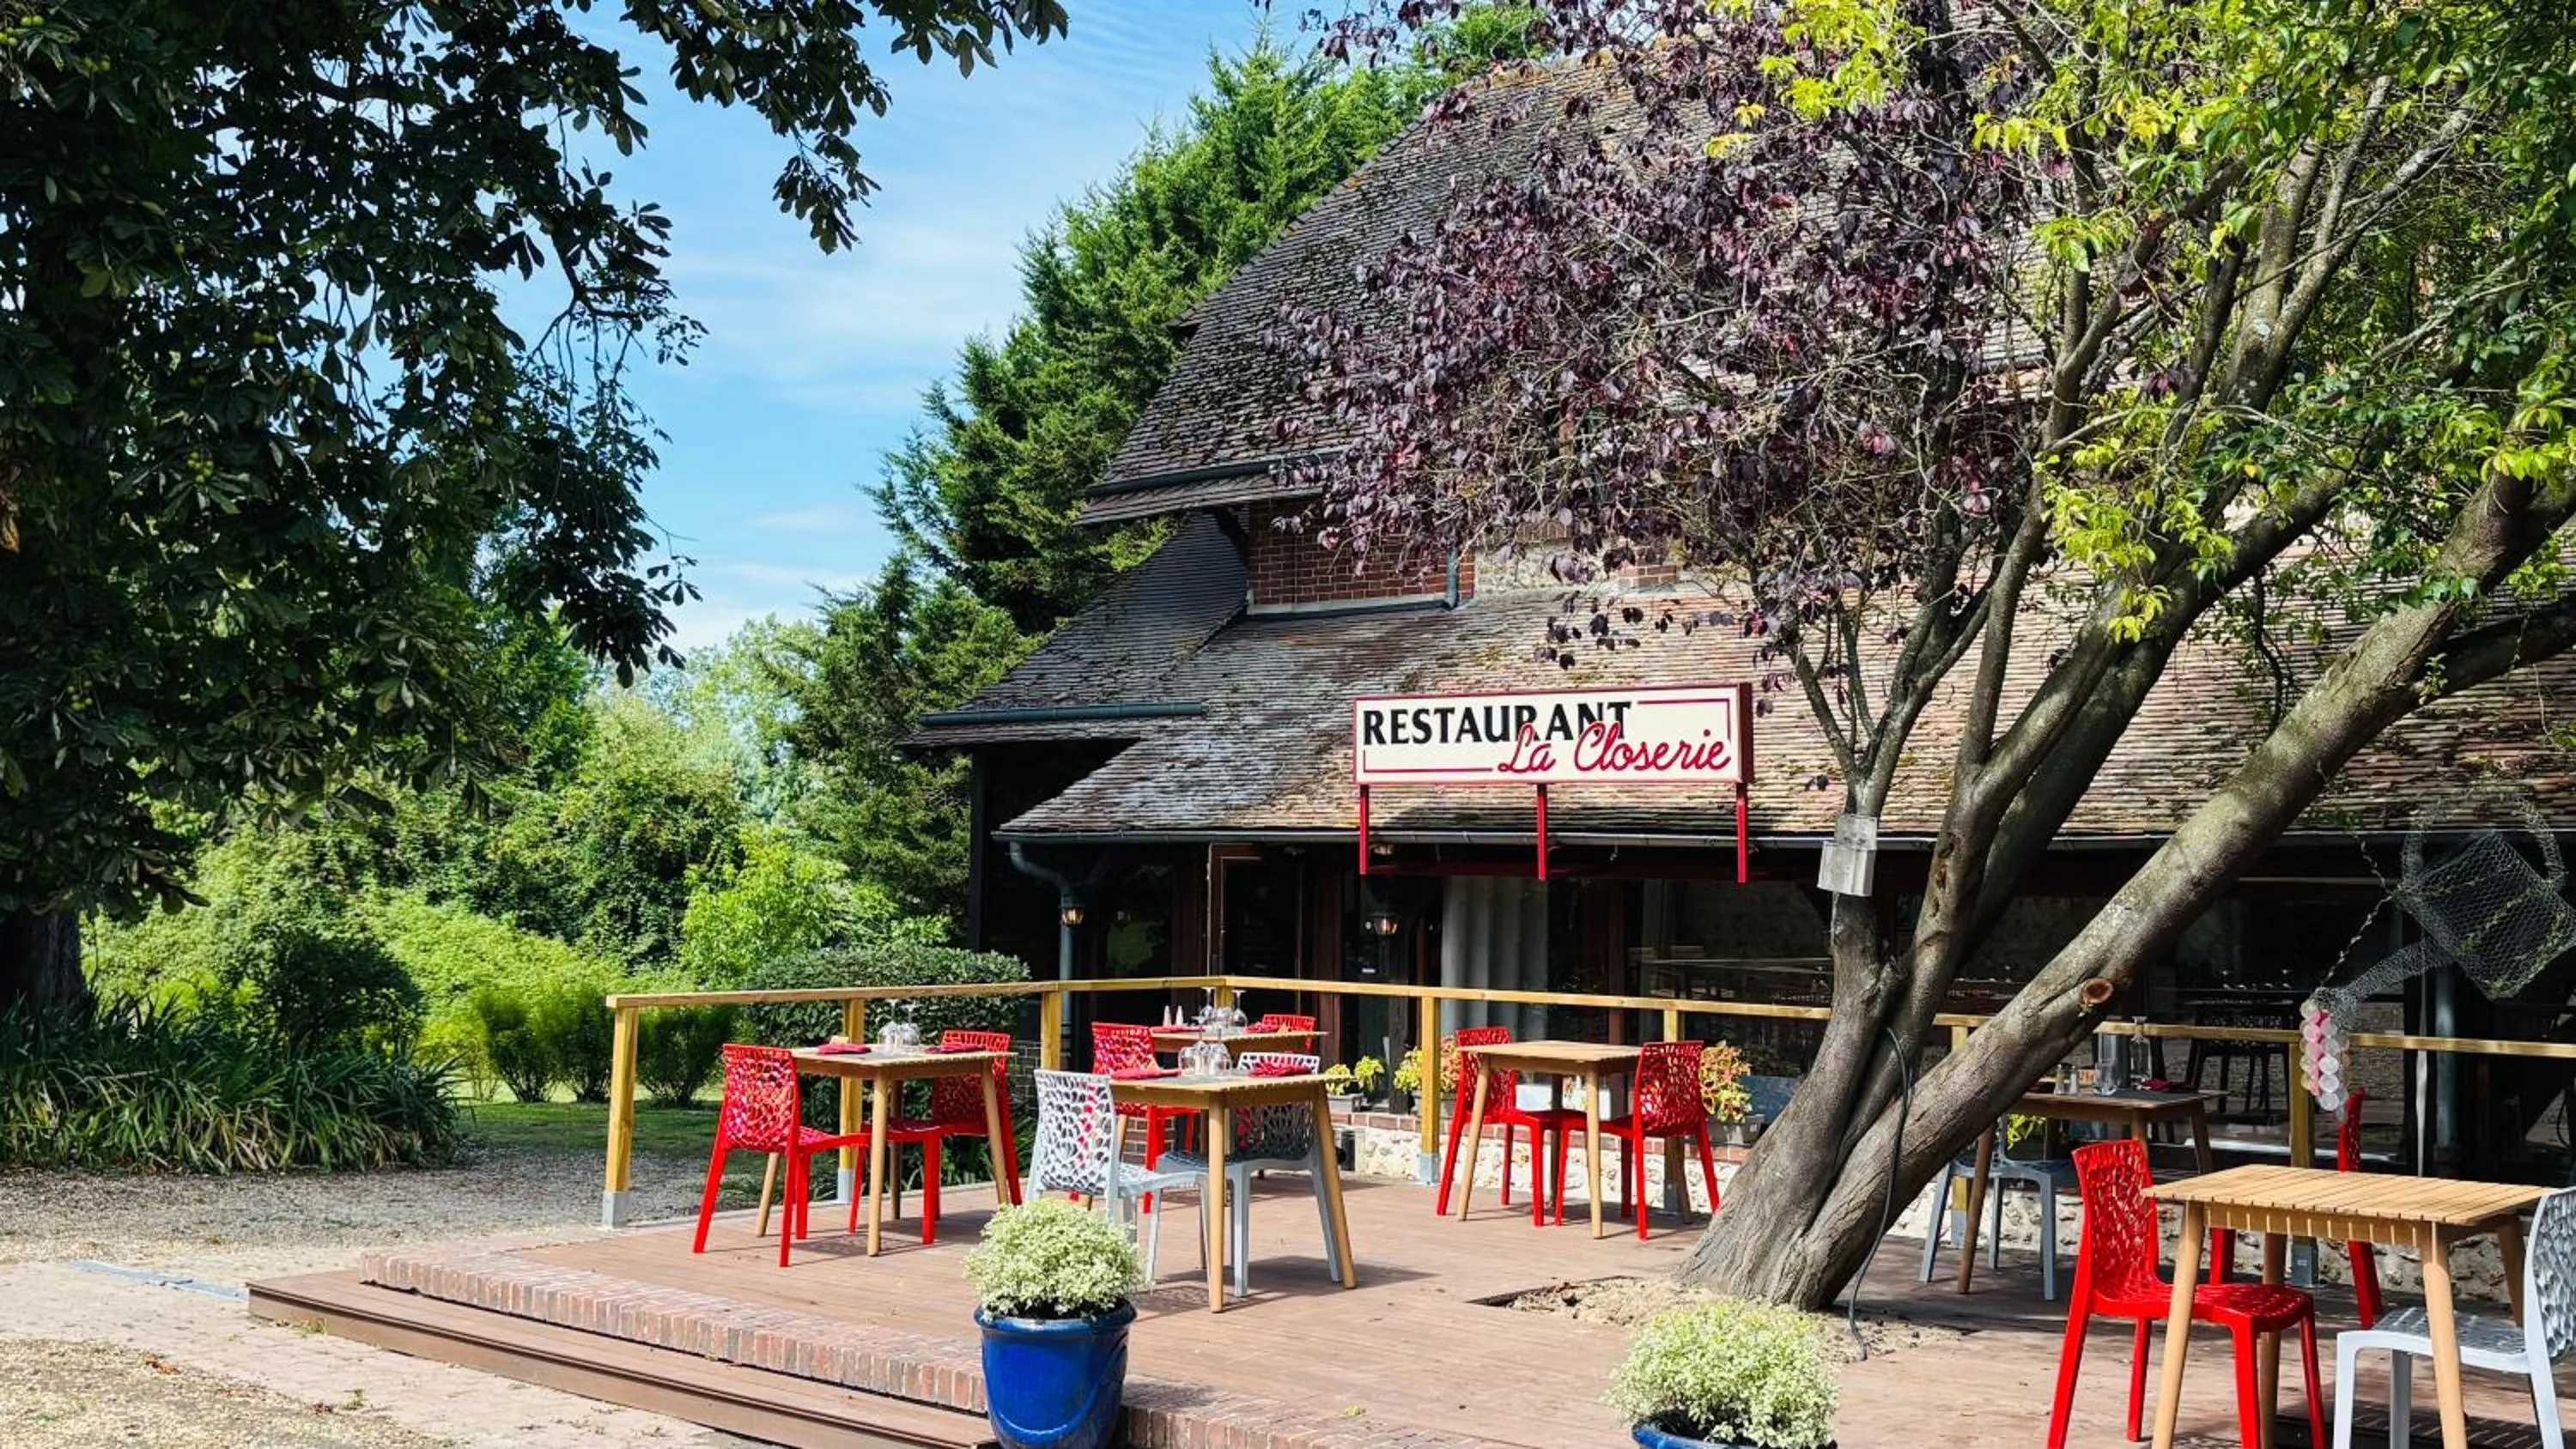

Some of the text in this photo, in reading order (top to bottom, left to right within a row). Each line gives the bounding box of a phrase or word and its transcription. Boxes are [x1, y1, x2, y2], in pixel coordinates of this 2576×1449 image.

[1364, 702, 1631, 744] RESTAURANT
[1498, 722, 1730, 773] La Closerie
